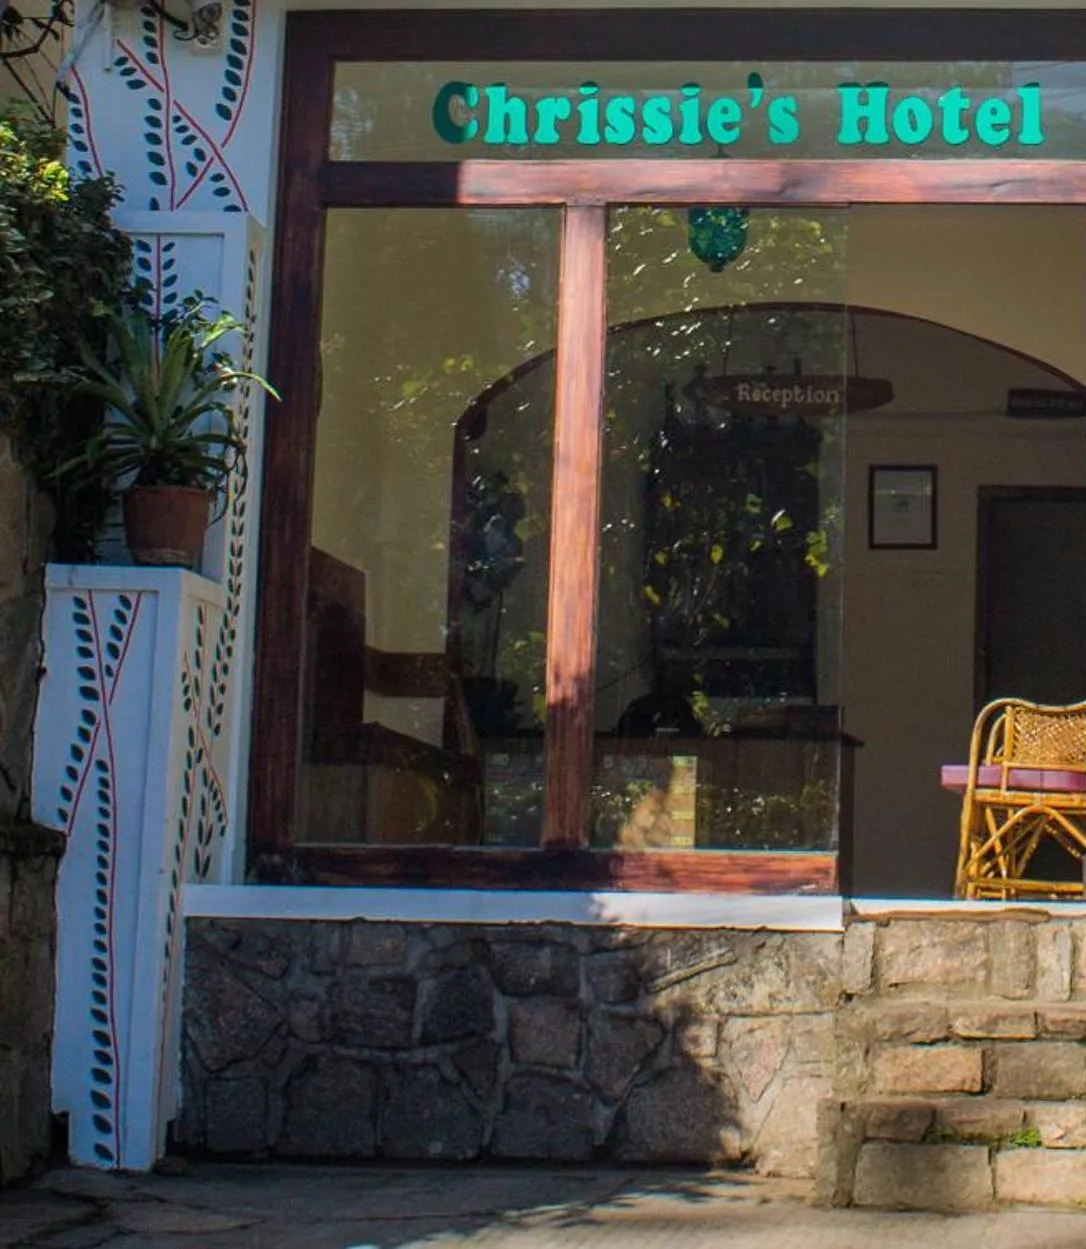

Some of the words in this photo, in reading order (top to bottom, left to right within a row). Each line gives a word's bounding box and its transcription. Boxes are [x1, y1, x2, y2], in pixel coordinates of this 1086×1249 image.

[432, 72, 798, 145] Chrissie's
[837, 81, 1042, 146] Hotel
[737, 383, 839, 408] Reception
